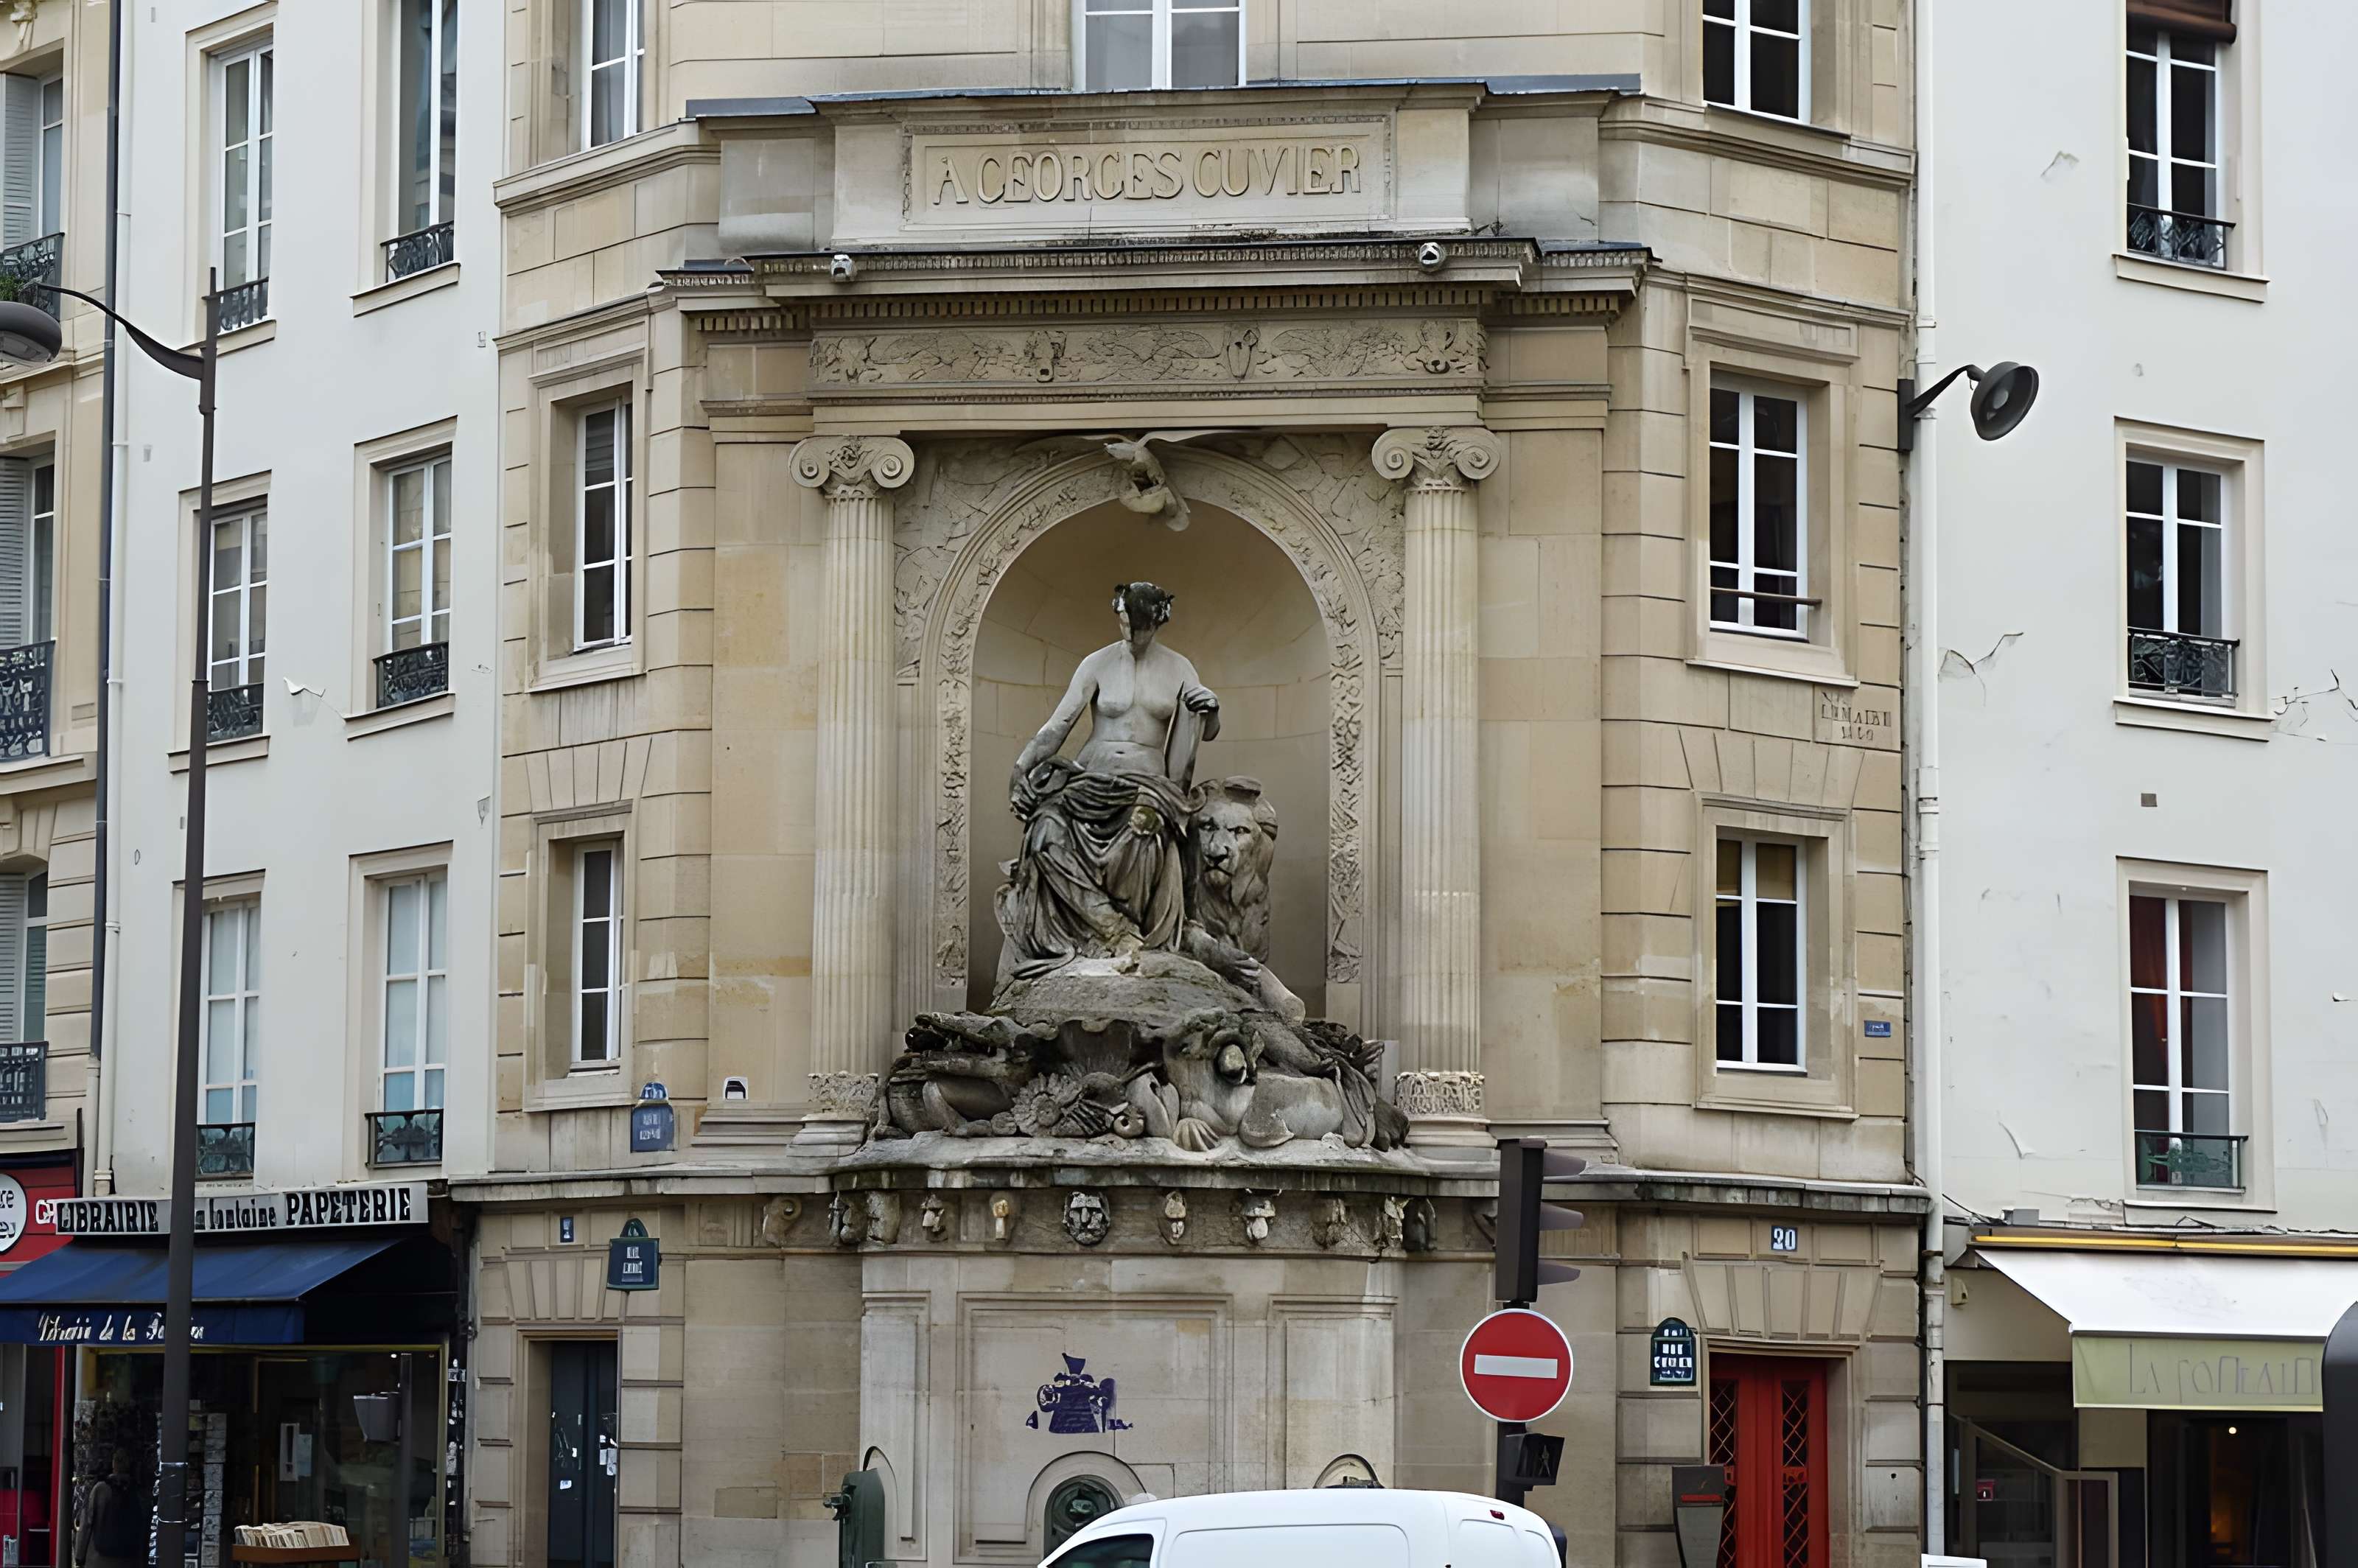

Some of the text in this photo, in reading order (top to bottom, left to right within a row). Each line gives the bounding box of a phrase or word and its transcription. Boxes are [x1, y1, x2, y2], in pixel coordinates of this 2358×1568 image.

[1193, 143, 1362, 197] CUVIER
[57, 1201, 159, 1233] LIBRAIRIE
[285, 1187, 411, 1227] PAPETERIE
